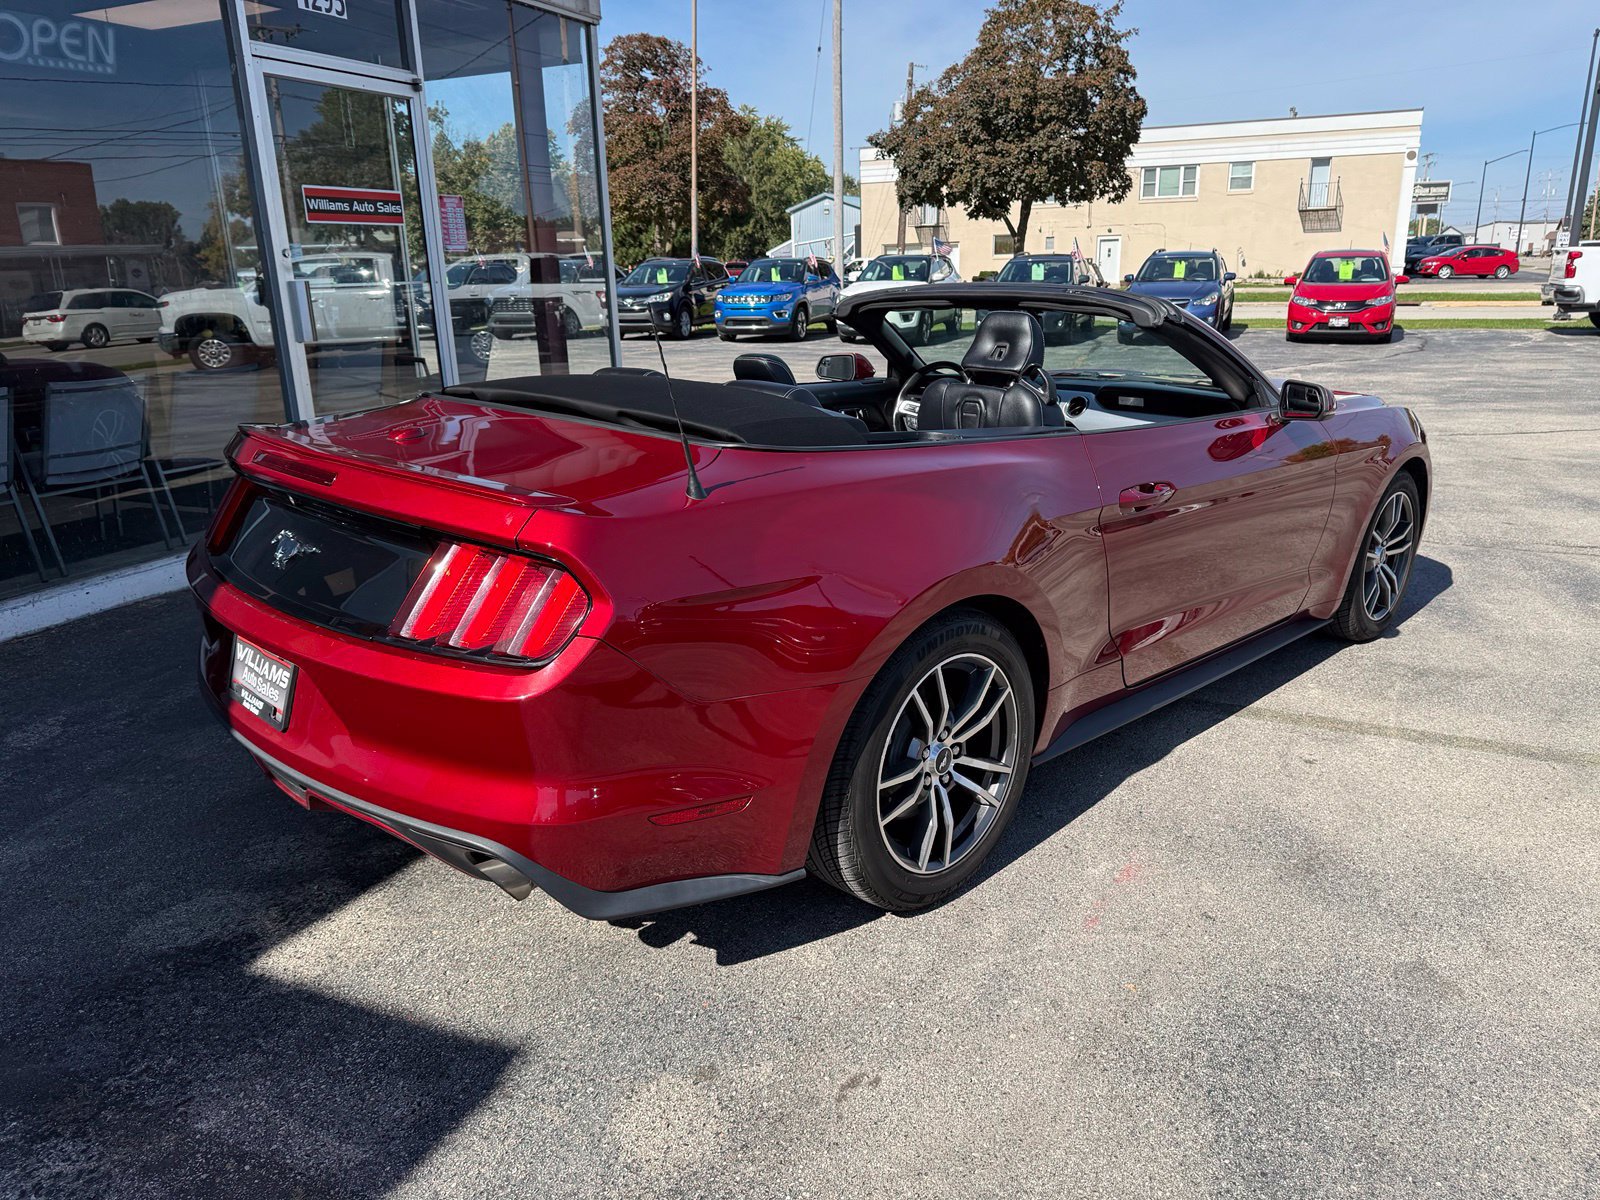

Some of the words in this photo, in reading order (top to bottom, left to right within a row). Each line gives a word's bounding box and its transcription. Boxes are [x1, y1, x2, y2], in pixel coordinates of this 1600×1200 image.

[0, 12, 115, 65] OPEN
[307, 198, 350, 211] Williams
[352, 201, 375, 212] Auto
[377, 202, 402, 213] Sales
[236, 642, 291, 689] WILLIAMS
[242, 666, 257, 687] Auto
[256, 677, 279, 702] Sales
